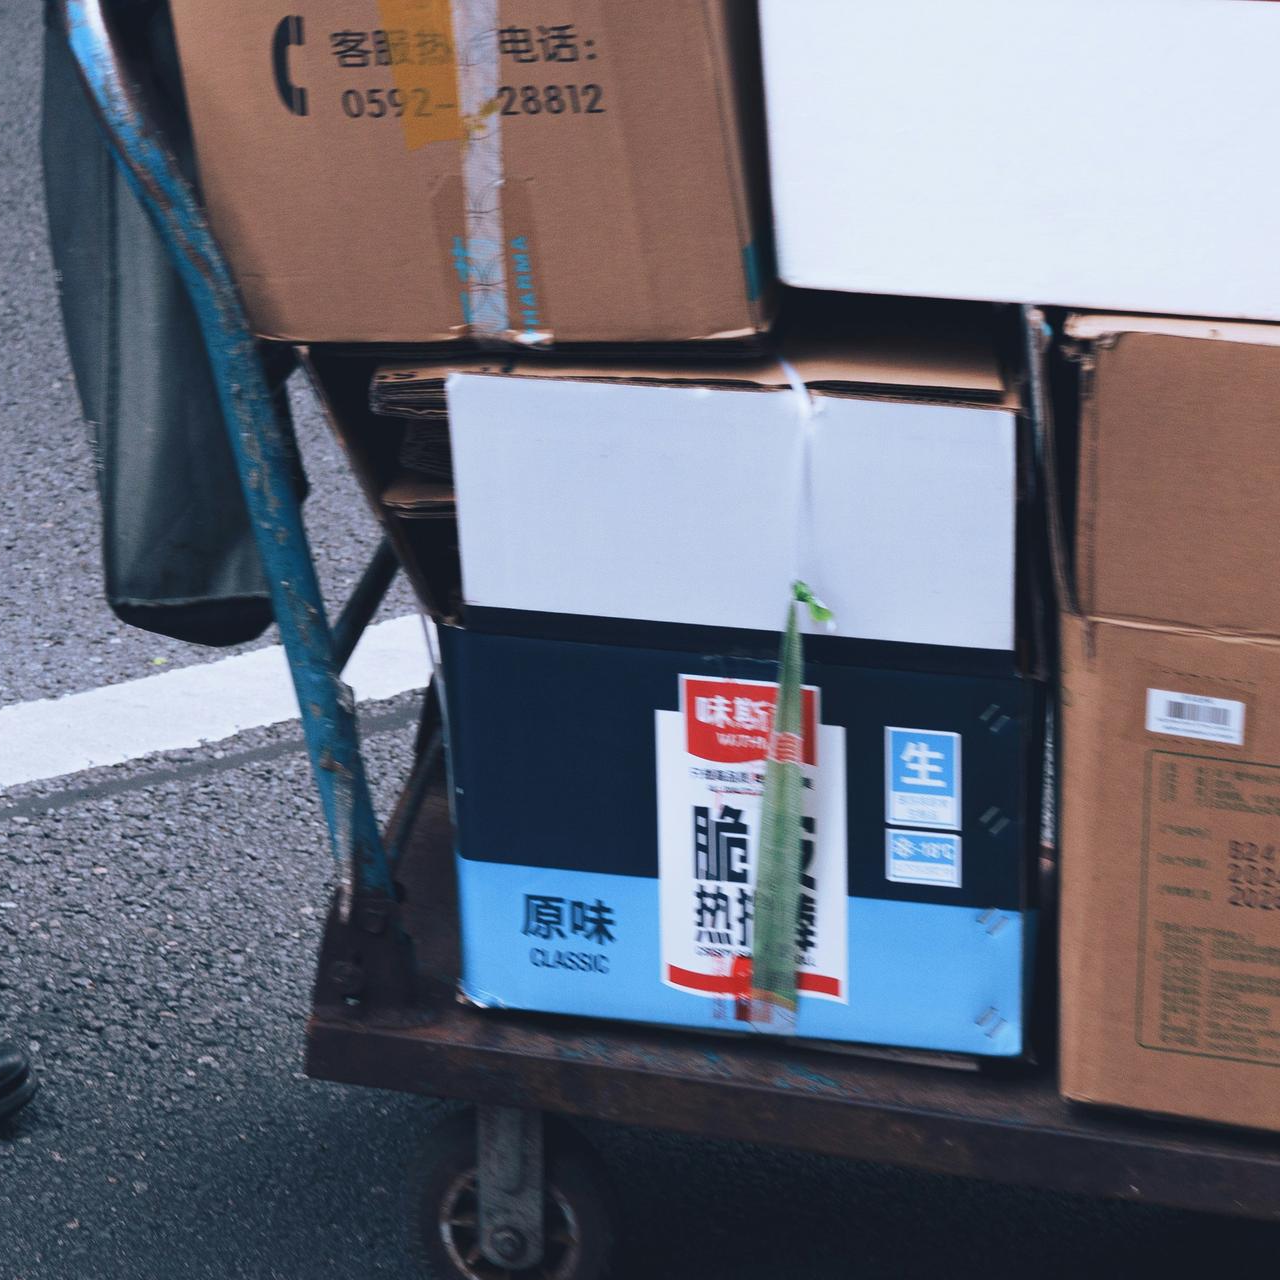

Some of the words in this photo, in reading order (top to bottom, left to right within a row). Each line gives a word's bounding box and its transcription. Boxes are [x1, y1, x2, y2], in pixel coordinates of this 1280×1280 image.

[330, 25, 597, 68] 客服热电话：
[340, 83, 607, 118] 0592-28812
[695, 694, 778, 734] 味斯
[899, 741, 948, 788] 生
[693, 805, 817, 893] 脆
[521, 893, 617, 946] 原味
[529, 946, 611, 975] CLASSIC
